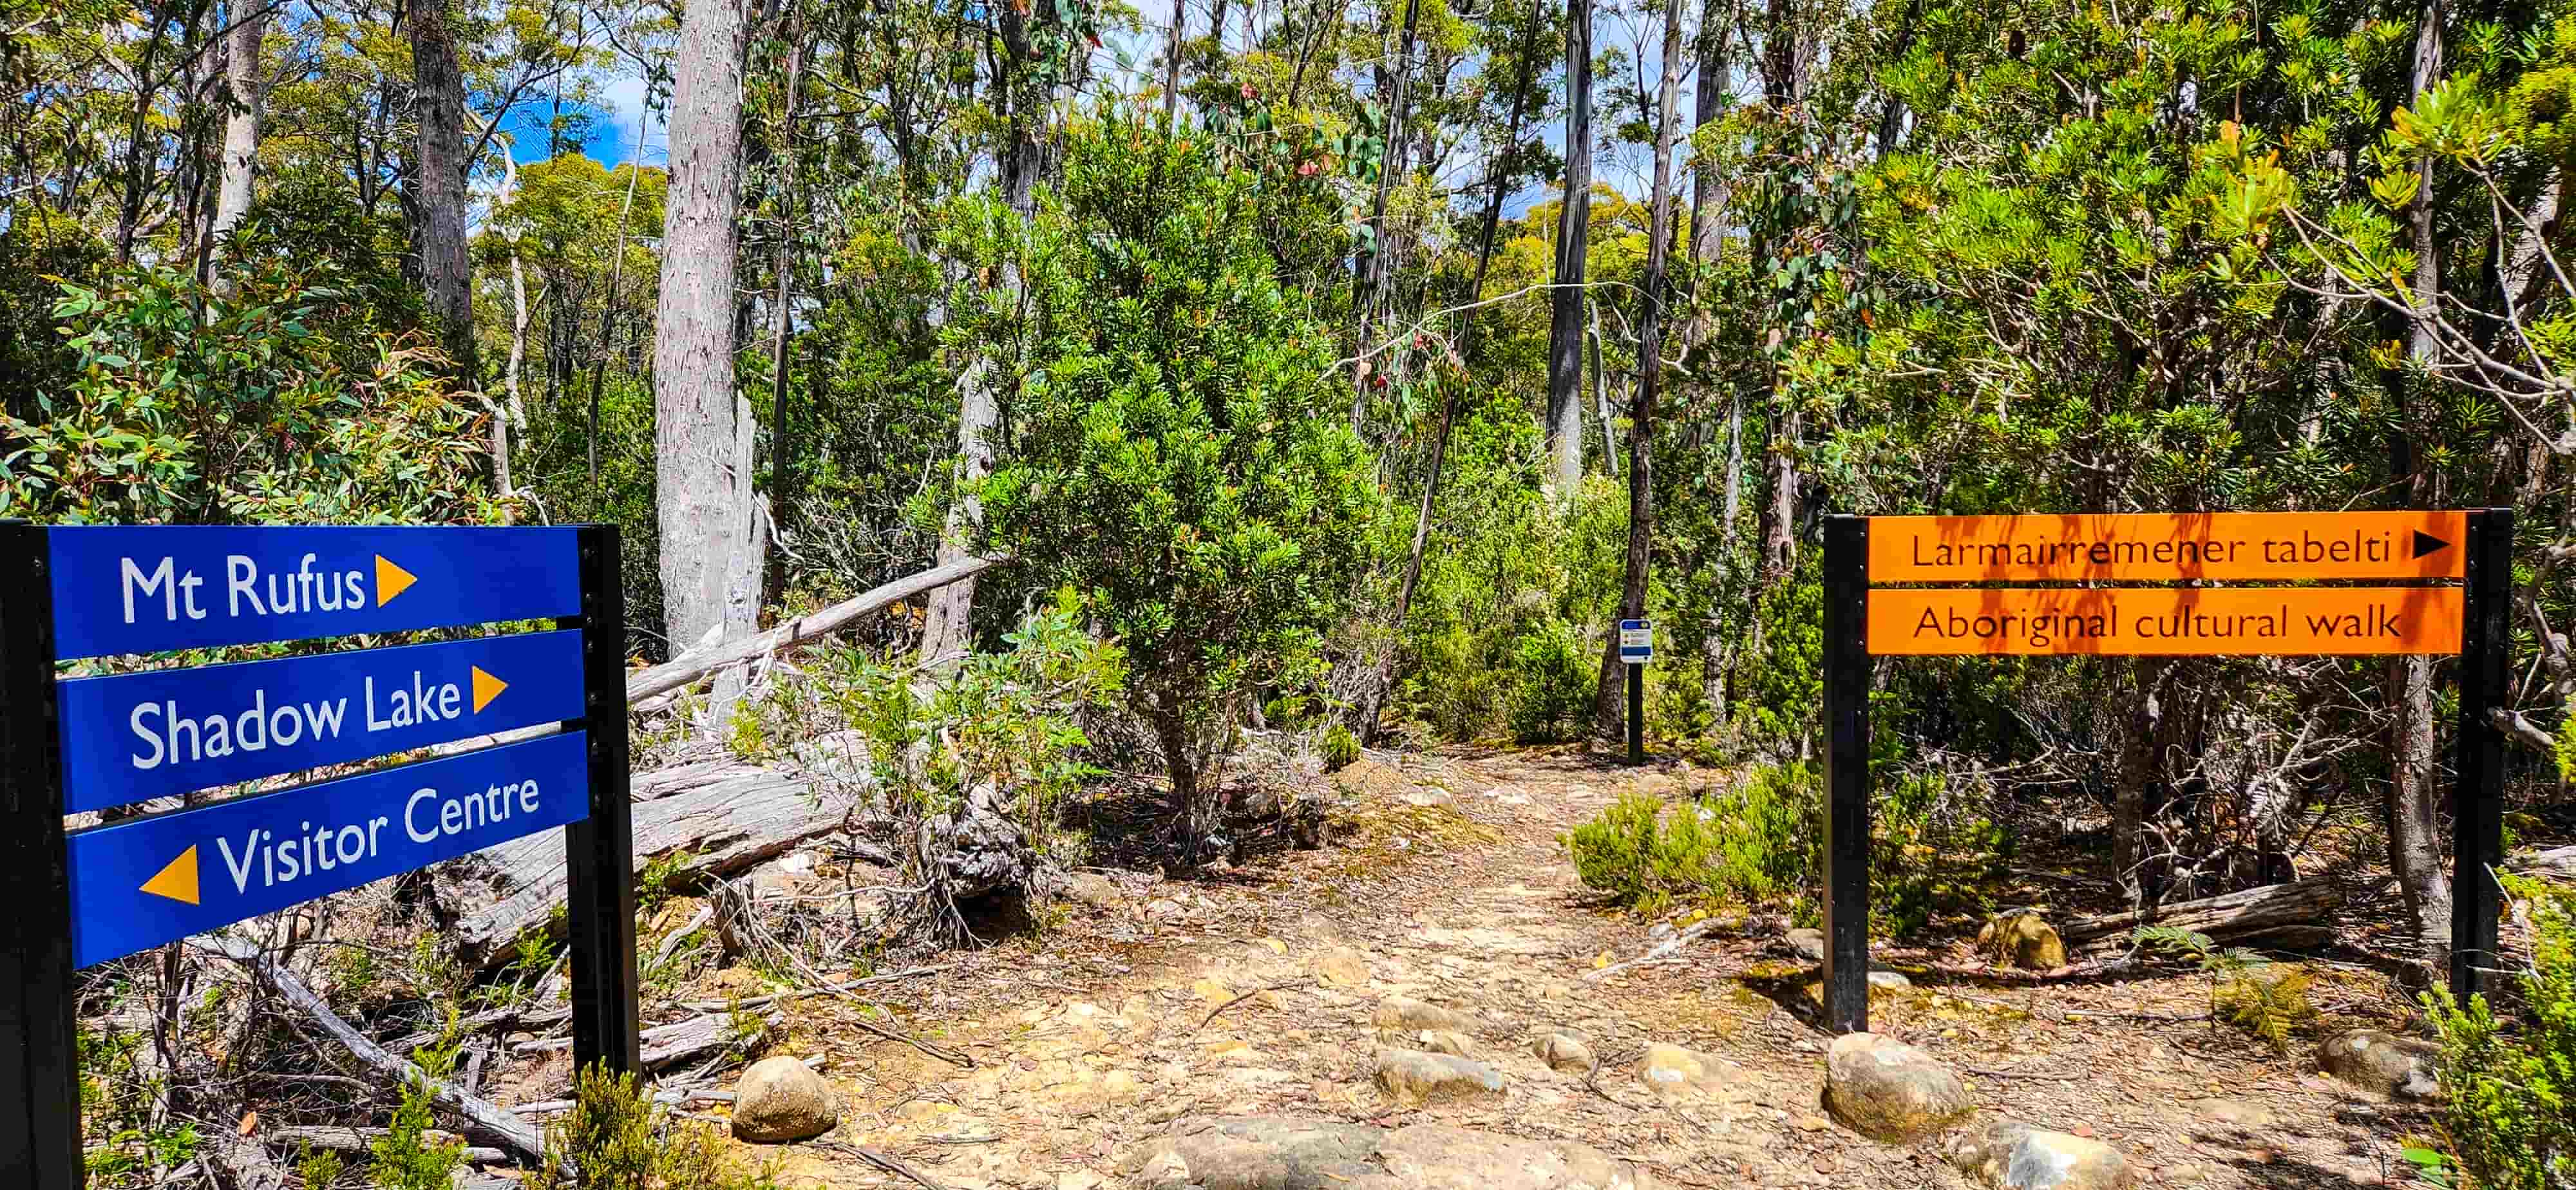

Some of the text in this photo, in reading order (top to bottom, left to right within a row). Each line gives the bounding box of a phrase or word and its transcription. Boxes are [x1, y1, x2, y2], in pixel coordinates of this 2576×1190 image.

[1912, 530, 2391, 566] Larmairremener tabelti
[121, 552, 366, 624] Mt Rufus
[1913, 603, 2401, 648] Aboriginal cultural walk
[130, 670, 461, 770] Shadow Lake
[217, 778, 540, 895] Visitor Centre
